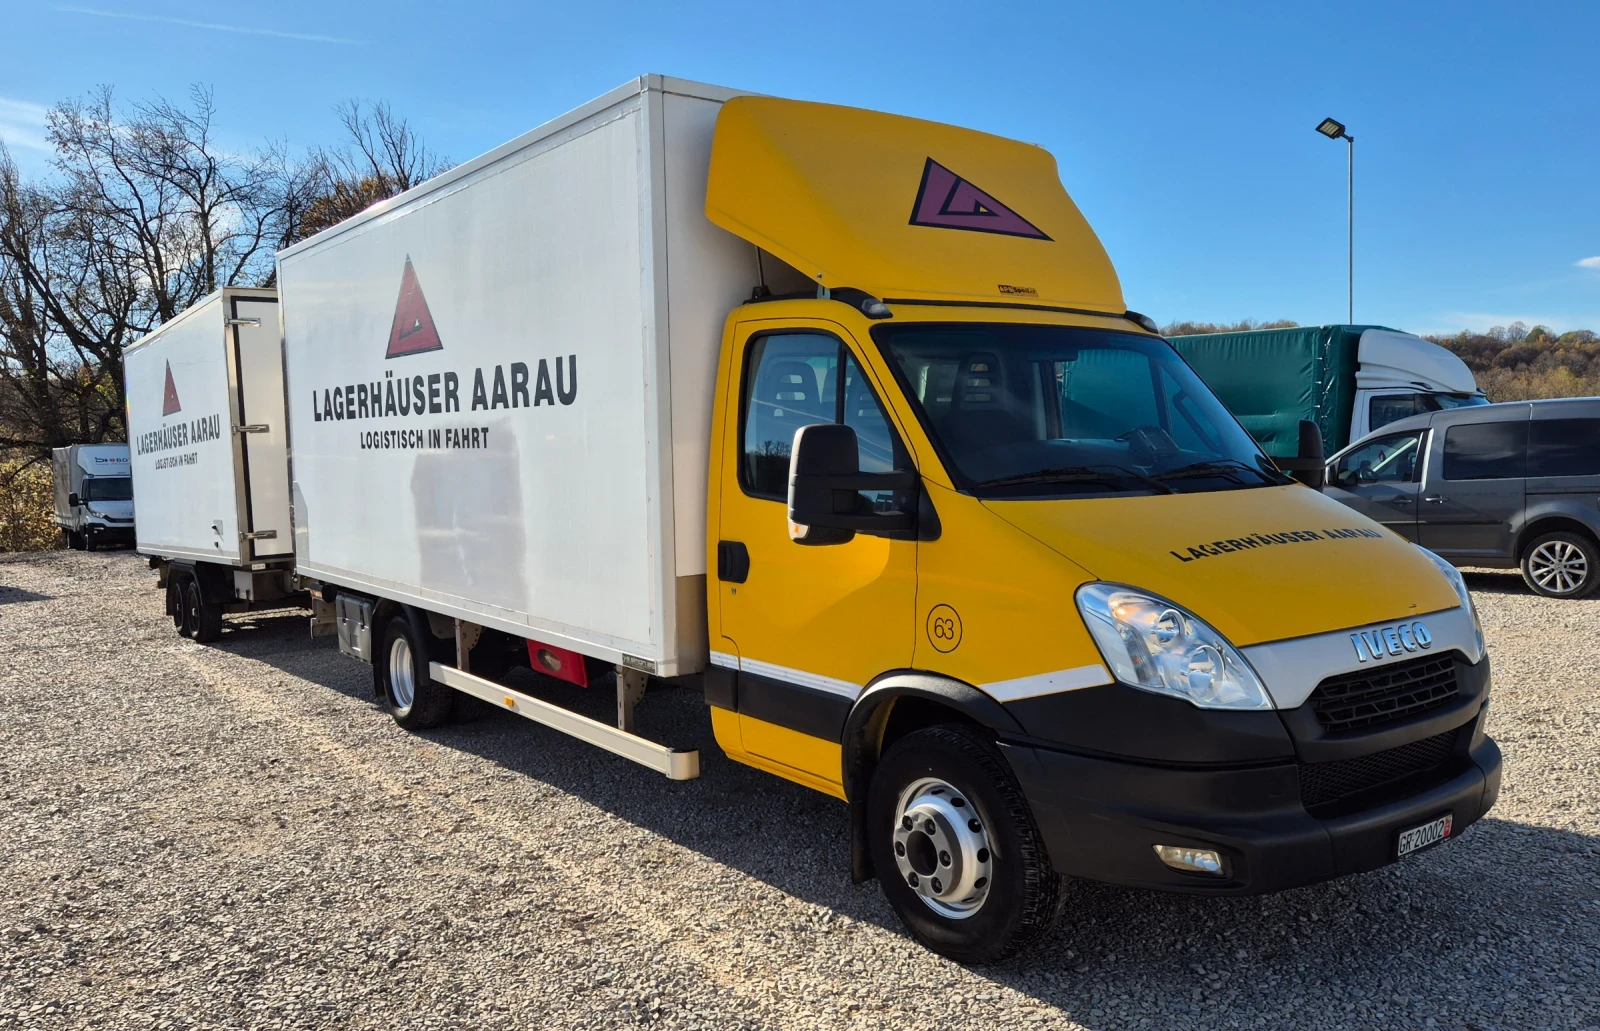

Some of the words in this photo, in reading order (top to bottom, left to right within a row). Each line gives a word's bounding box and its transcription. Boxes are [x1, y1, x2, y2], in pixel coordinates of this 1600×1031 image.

[313, 370, 460, 422] LAGERHÄUSER
[471, 354, 578, 411] AARAU
[136, 423, 188, 456] LAGERHÄUSER
[191, 413, 220, 444] AARAU
[360, 429, 423, 449] LOGISTISCH
[428, 429, 441, 449] IN
[445, 427, 489, 449] FAHRT
[178, 454, 184, 466] IN
[184, 452, 198, 466] FAHRT
[1169, 530, 1325, 563] LAGERHÄUSER
[1321, 528, 1383, 540] AARAU
[933, 617, 954, 640] 63
[1350, 621, 1432, 662] IVECO
